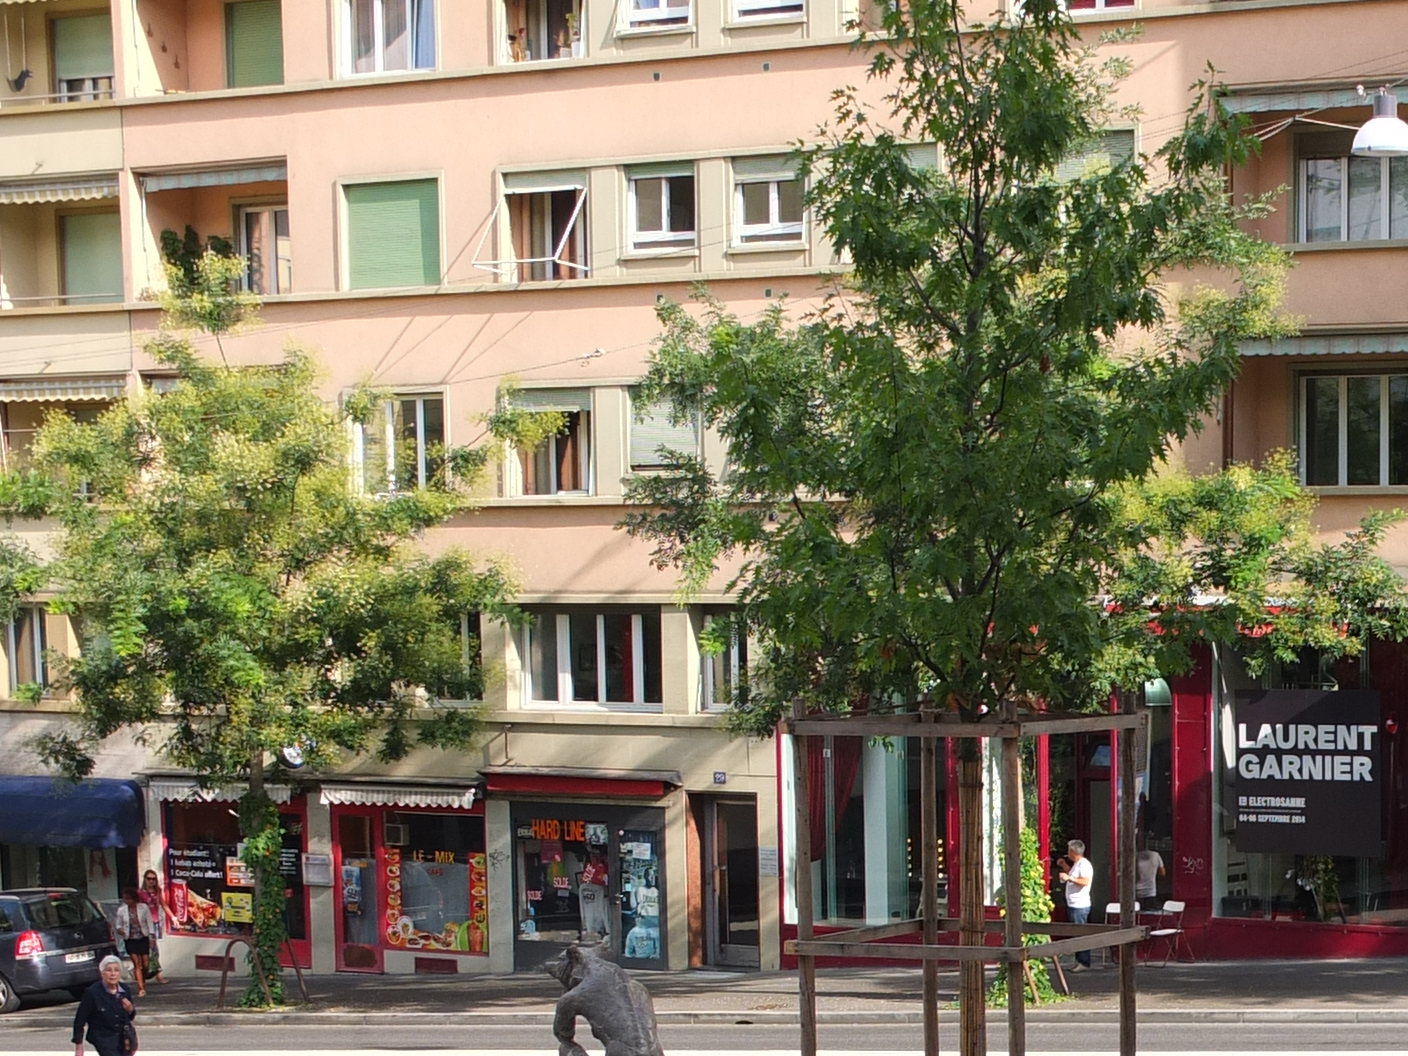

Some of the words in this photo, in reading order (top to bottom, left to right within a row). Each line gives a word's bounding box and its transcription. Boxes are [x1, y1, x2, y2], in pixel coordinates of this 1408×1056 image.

[1238, 723, 1378, 751] LAURENT
[1238, 753, 1373, 782] GARNIER
[531, 818, 560, 840] HARD
[564, 820, 585, 842] LINE
[413, 849, 425, 863] LE
[435, 850, 455, 864] MIX
[553, 877, 570, 888] SOLDE
